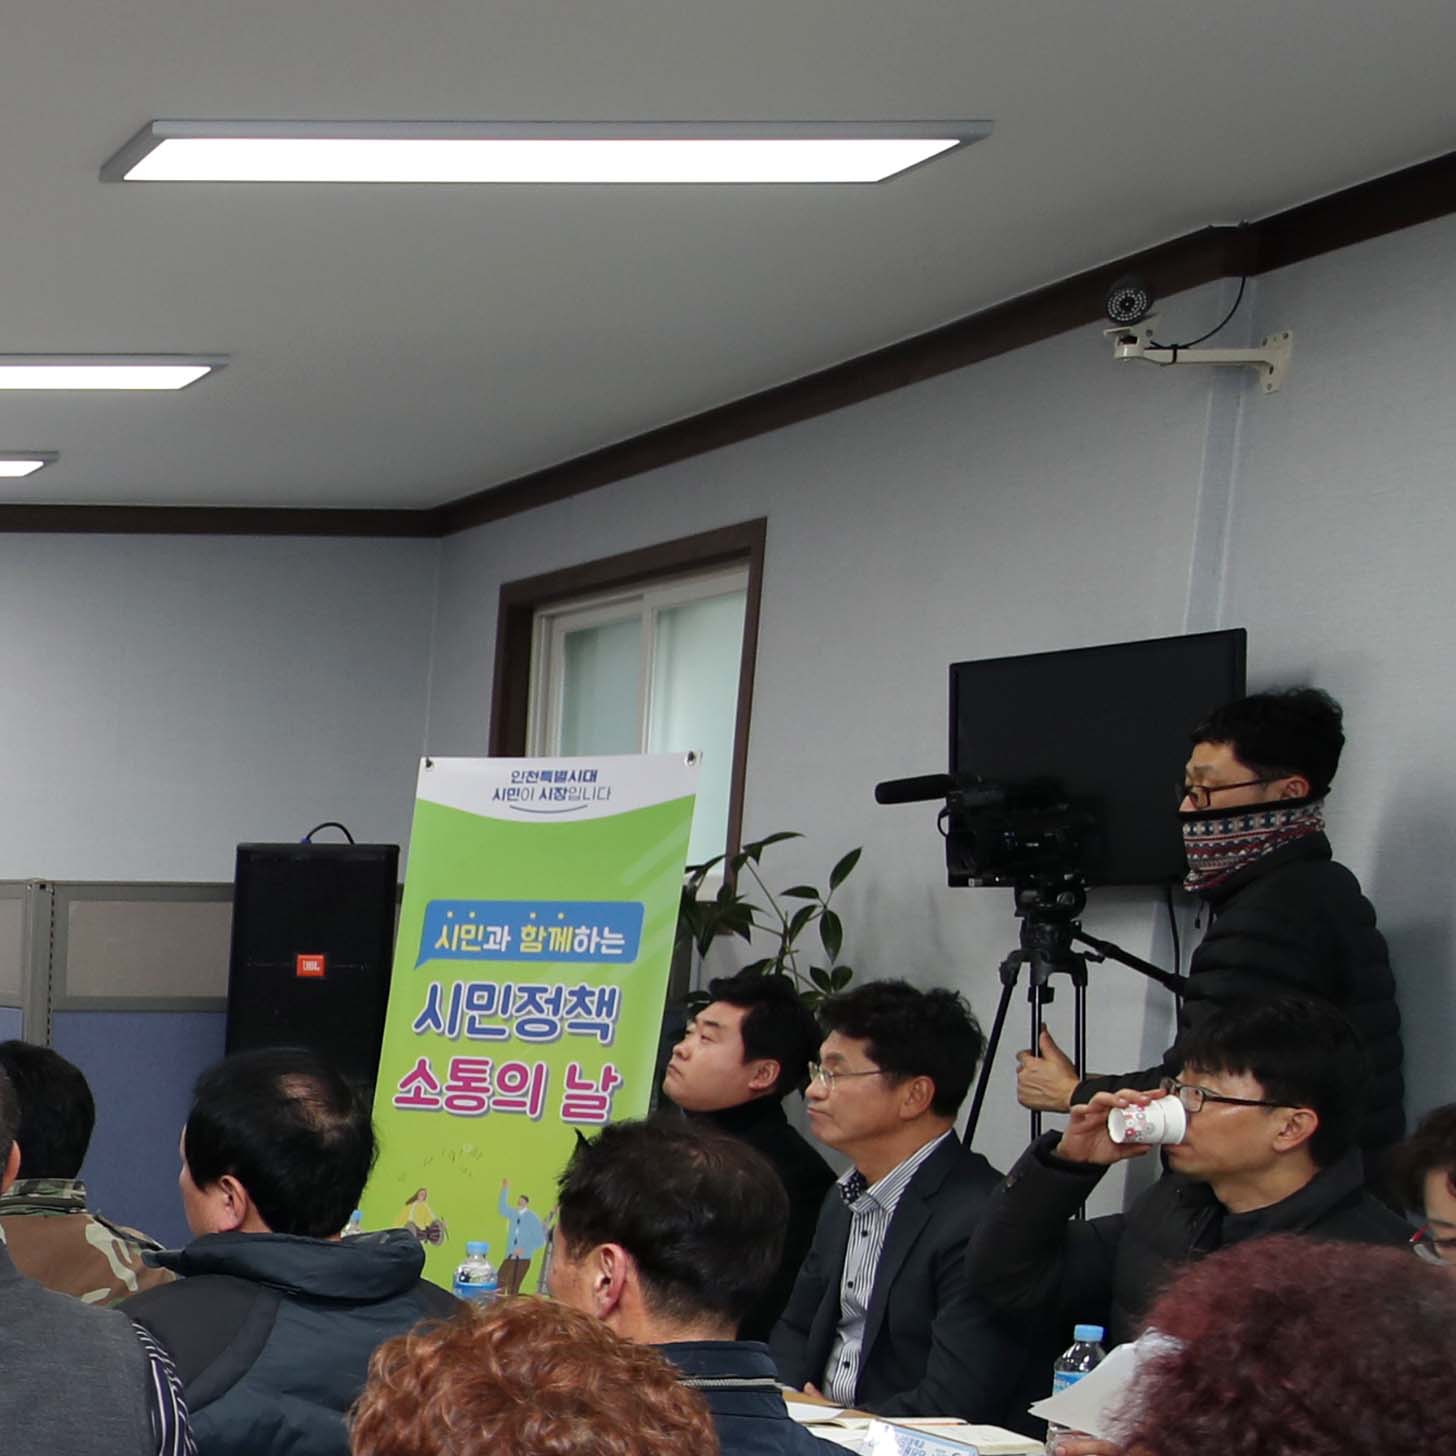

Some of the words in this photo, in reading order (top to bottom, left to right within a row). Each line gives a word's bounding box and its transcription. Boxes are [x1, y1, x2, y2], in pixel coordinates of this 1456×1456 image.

[511, 769, 598, 784] 인천특별시대
[492, 787, 535, 801] 시민이
[539, 785, 612, 801] 시장입니다
[435, 924, 511, 952] 시민과
[520, 924, 625, 954] 함께하는
[413, 981, 621, 1044] 시민정책
[393, 1056, 547, 1119] 소통의
[561, 1063, 621, 1122] 날
